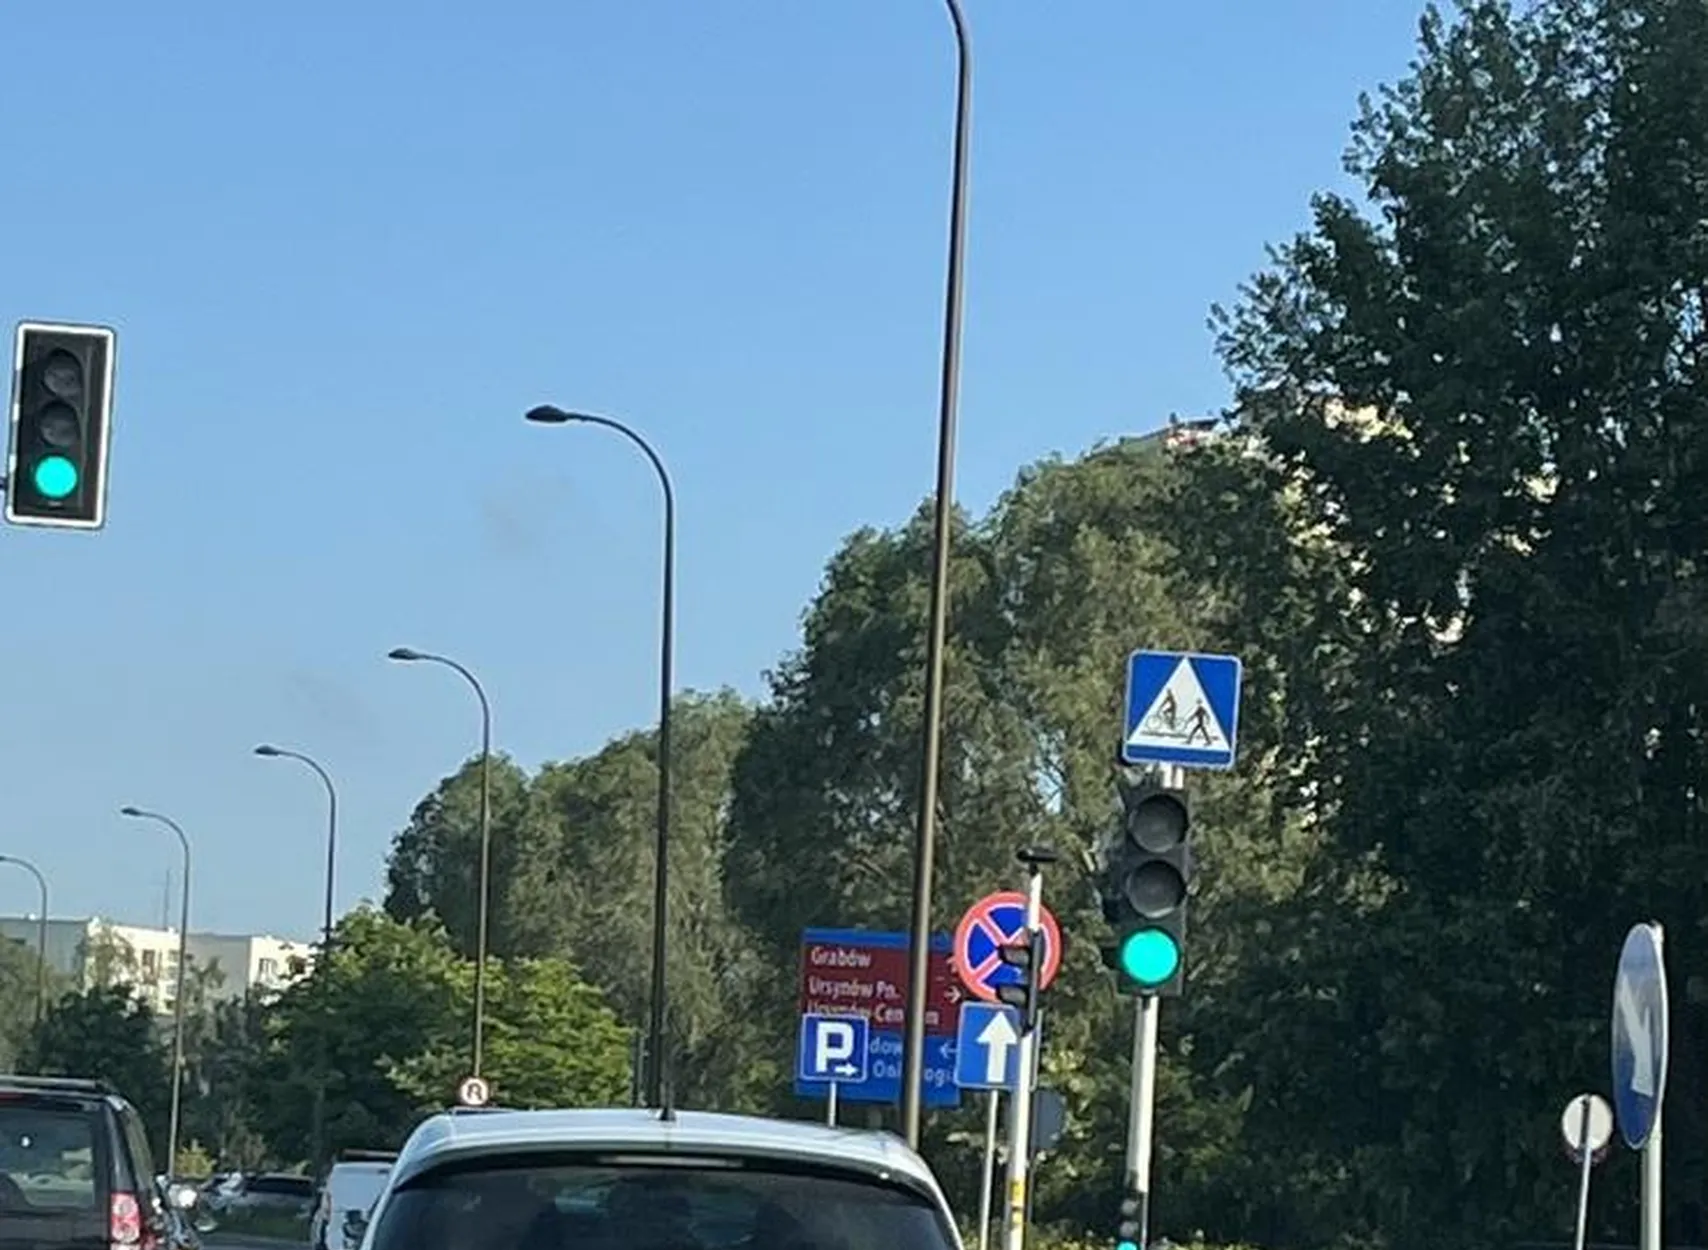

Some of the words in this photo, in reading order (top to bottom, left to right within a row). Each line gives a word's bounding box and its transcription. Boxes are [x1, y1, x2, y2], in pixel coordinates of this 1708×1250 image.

[810, 946, 871, 967] Grabów
[808, 976, 873, 999] Ursynów
[816, 1021, 854, 1072] P
